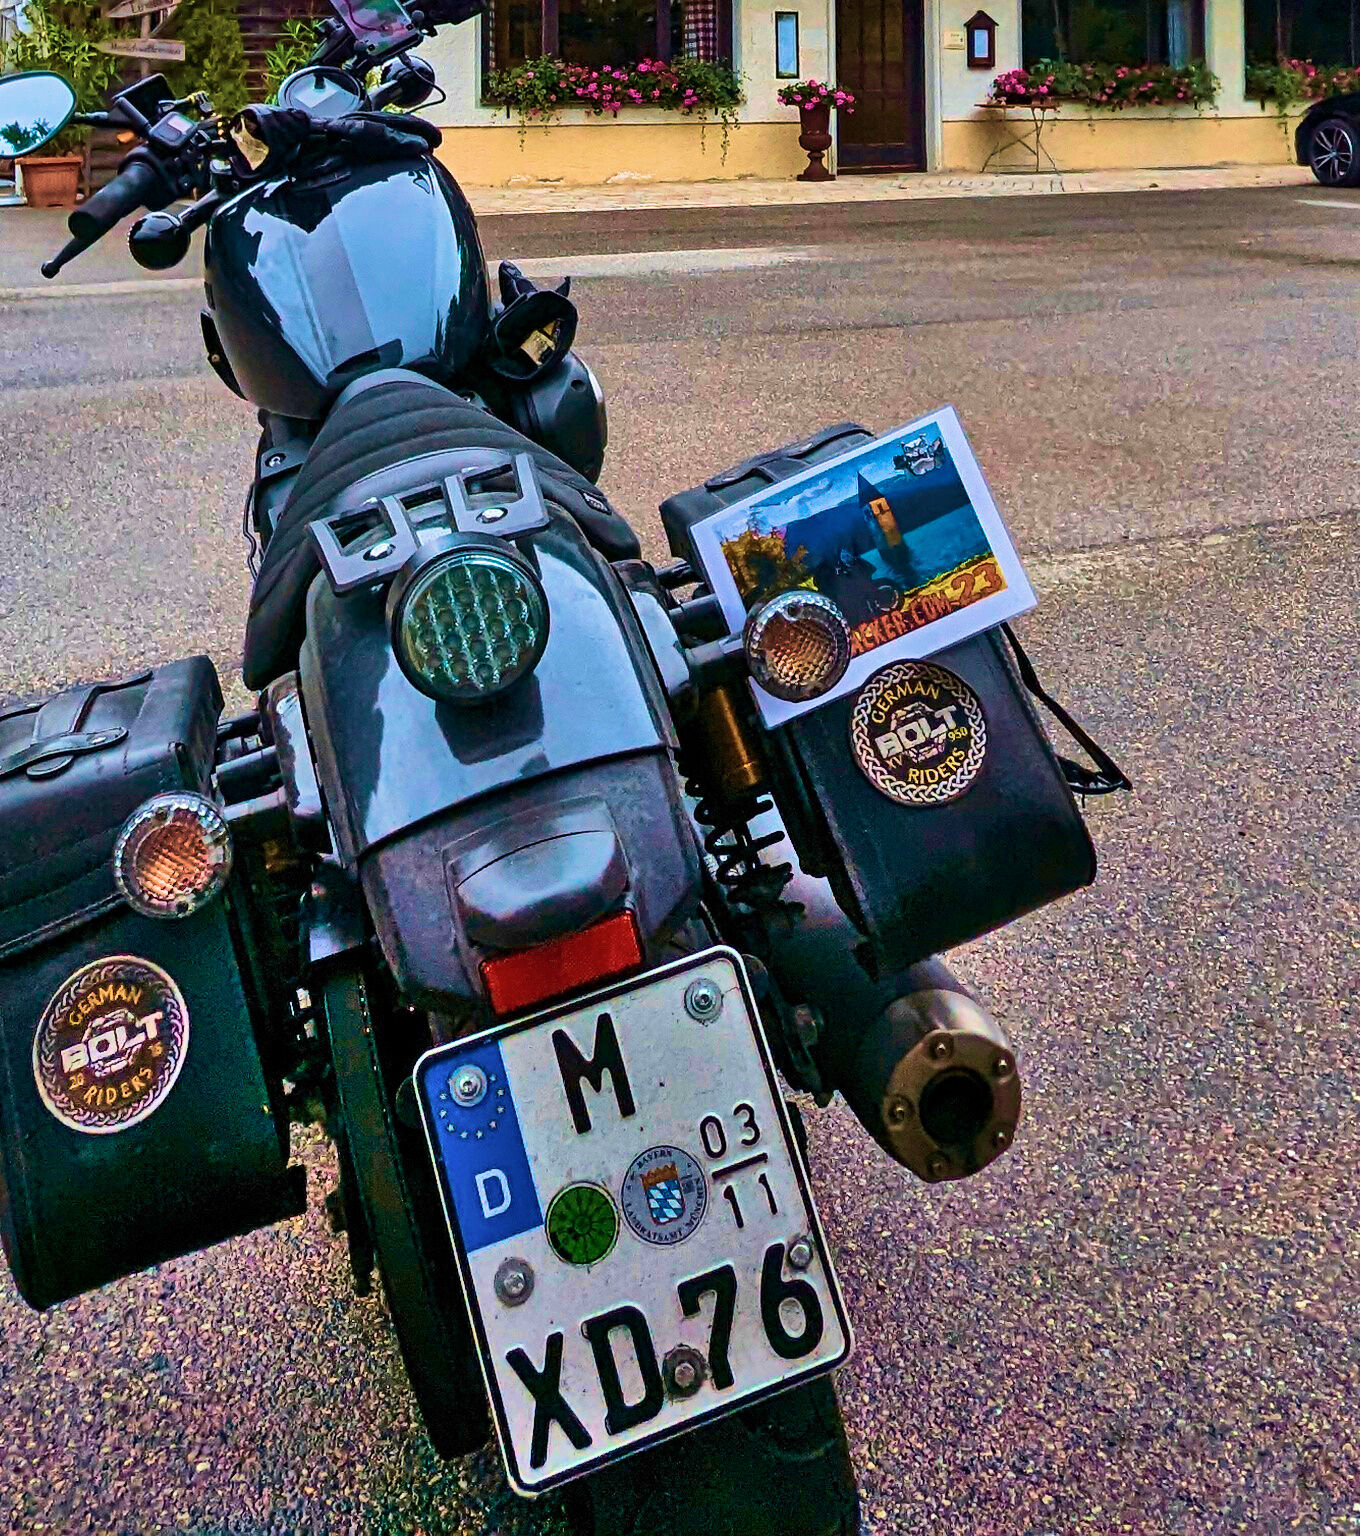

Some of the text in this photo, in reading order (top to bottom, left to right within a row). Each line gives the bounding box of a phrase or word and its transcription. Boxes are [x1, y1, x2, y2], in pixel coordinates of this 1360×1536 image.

[871, 681, 940, 725] GERMAN
[875, 704, 957, 759] BOLT
[948, 726, 968, 742] 950
[908, 747, 966, 785] RIDERS
[69, 984, 143, 1026] GERMAN
[60, 1011, 164, 1074] BOLT
[83, 1066, 153, 1106] RIDERS
[551, 1012, 636, 1134] M
[699, 1102, 761, 1159] 03
[475, 1167, 512, 1219] D
[723, 1172, 780, 1228] 11
[505, 1243, 826, 1469] XD 76
